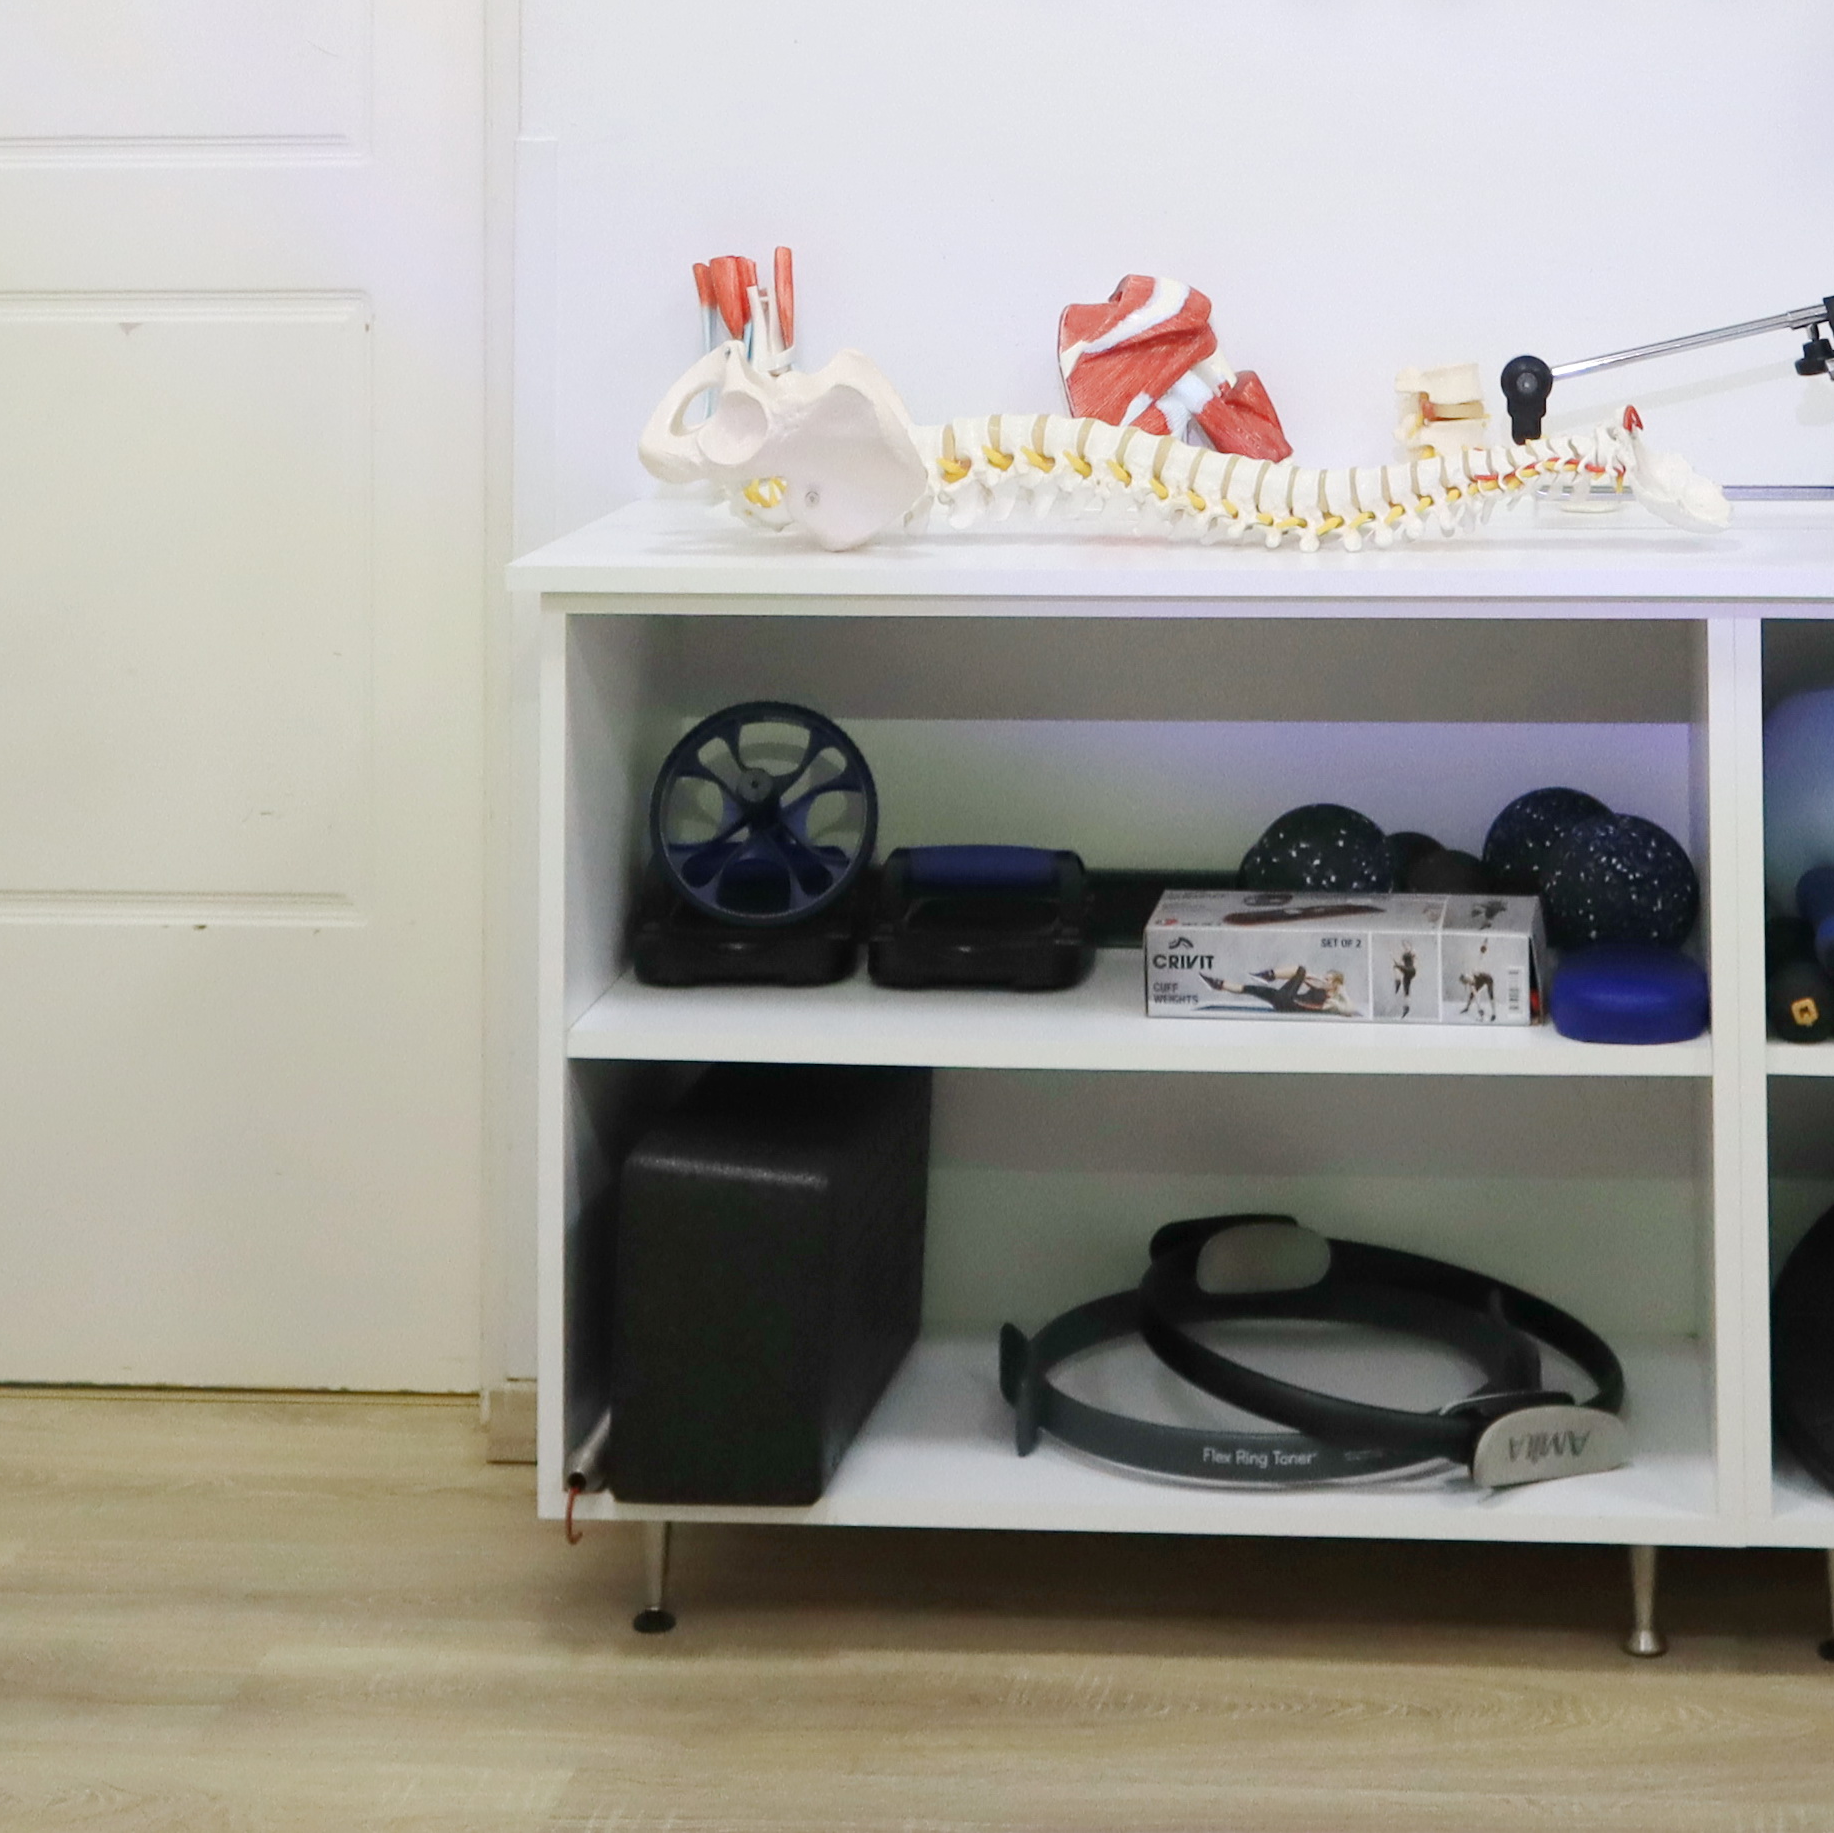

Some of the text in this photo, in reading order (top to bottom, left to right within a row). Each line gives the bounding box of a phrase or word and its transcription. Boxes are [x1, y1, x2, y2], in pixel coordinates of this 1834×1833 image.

[1320, 938, 1362, 949] SET OF 2
[1152, 954, 1215, 970] CRIVIT
[1153, 983, 1179, 993] CUFF
[1153, 993, 1200, 1006] WEIGHTS
[1202, 1447, 1313, 1468] Flex Ring Toner
